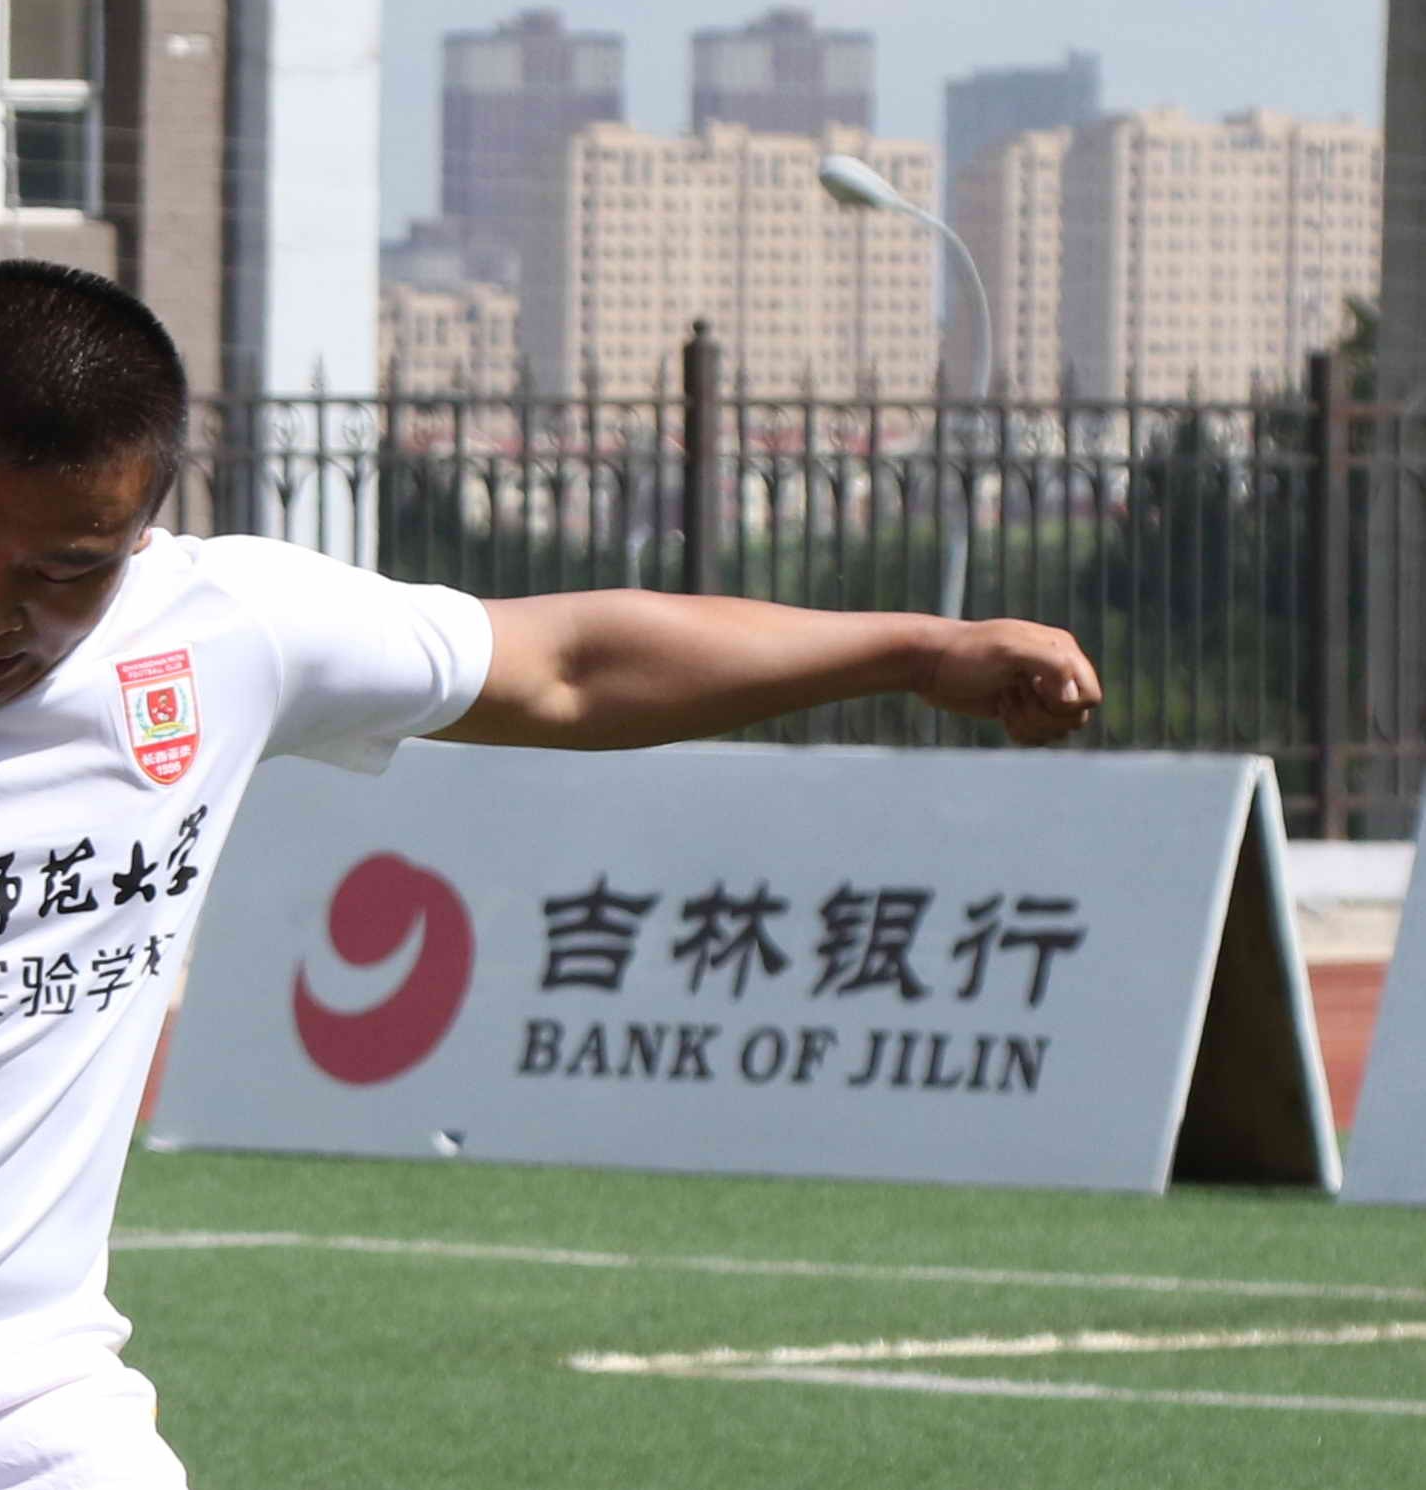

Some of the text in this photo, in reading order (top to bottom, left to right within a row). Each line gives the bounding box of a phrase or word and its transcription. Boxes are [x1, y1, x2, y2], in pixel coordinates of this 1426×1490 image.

[540, 873, 1086, 1005] 吉林银行
[517, 1020, 1050, 1093] BANK OF JILIN
